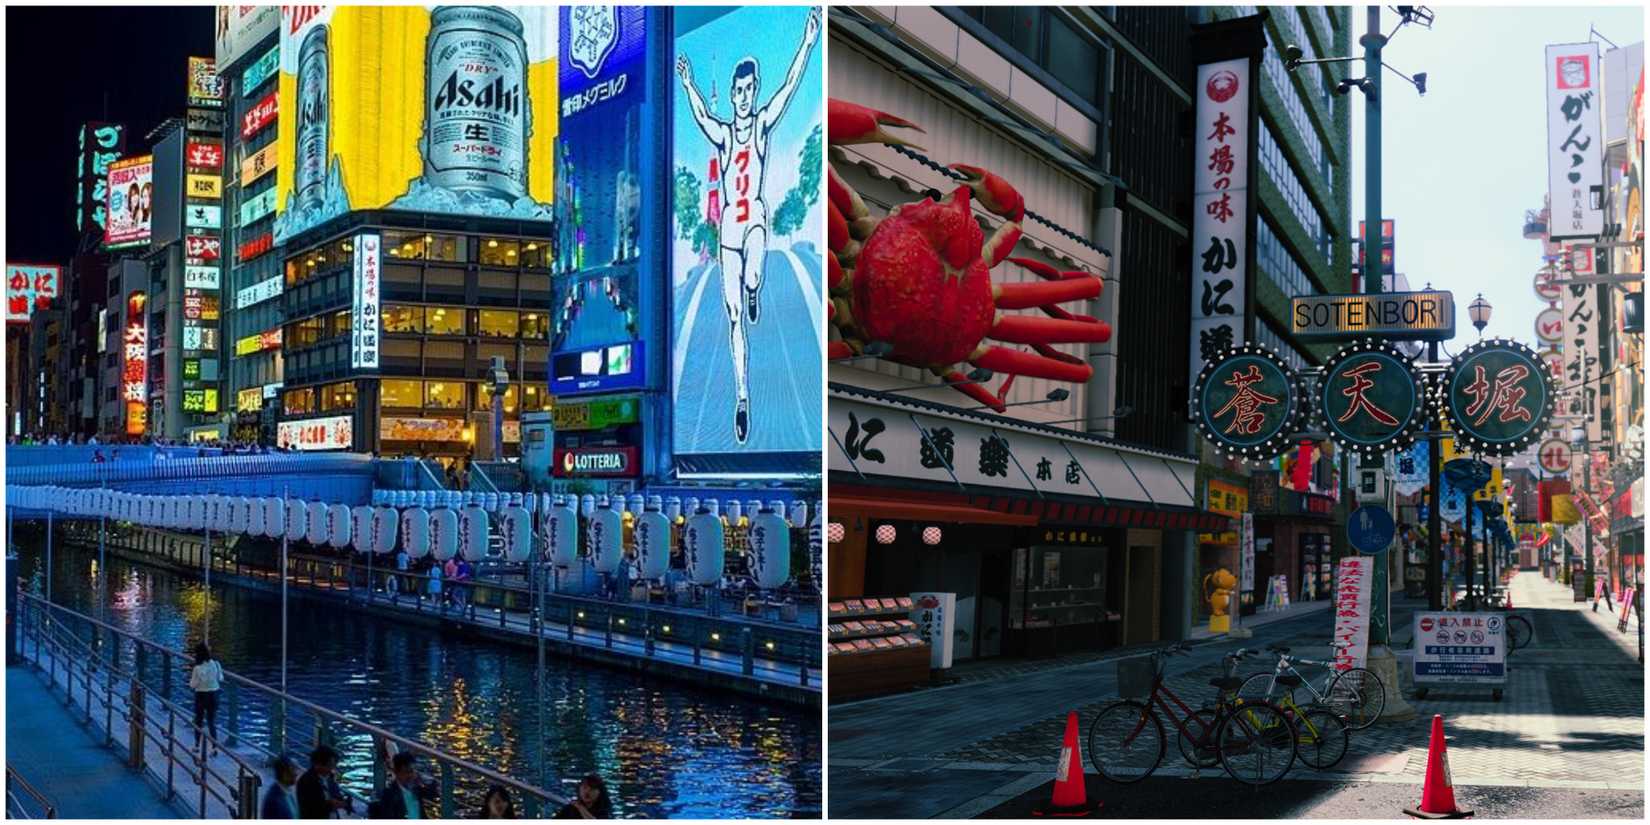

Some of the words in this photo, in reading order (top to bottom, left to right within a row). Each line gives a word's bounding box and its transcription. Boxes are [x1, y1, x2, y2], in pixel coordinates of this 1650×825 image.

[434, 70, 519, 117] Asahi
[465, 124, 490, 142] 生
[1560, 91, 1594, 184] がんこ
[735, 145, 751, 223] グリコ
[1207, 111, 1235, 224] 本場の味
[9, 270, 54, 292] かに
[1295, 300, 1447, 329] SOTENBORI
[1213, 361, 1533, 435] 蒼天堀
[575, 452, 621, 468] LOTTERIA
[1036, 456, 1082, 485] 本店
